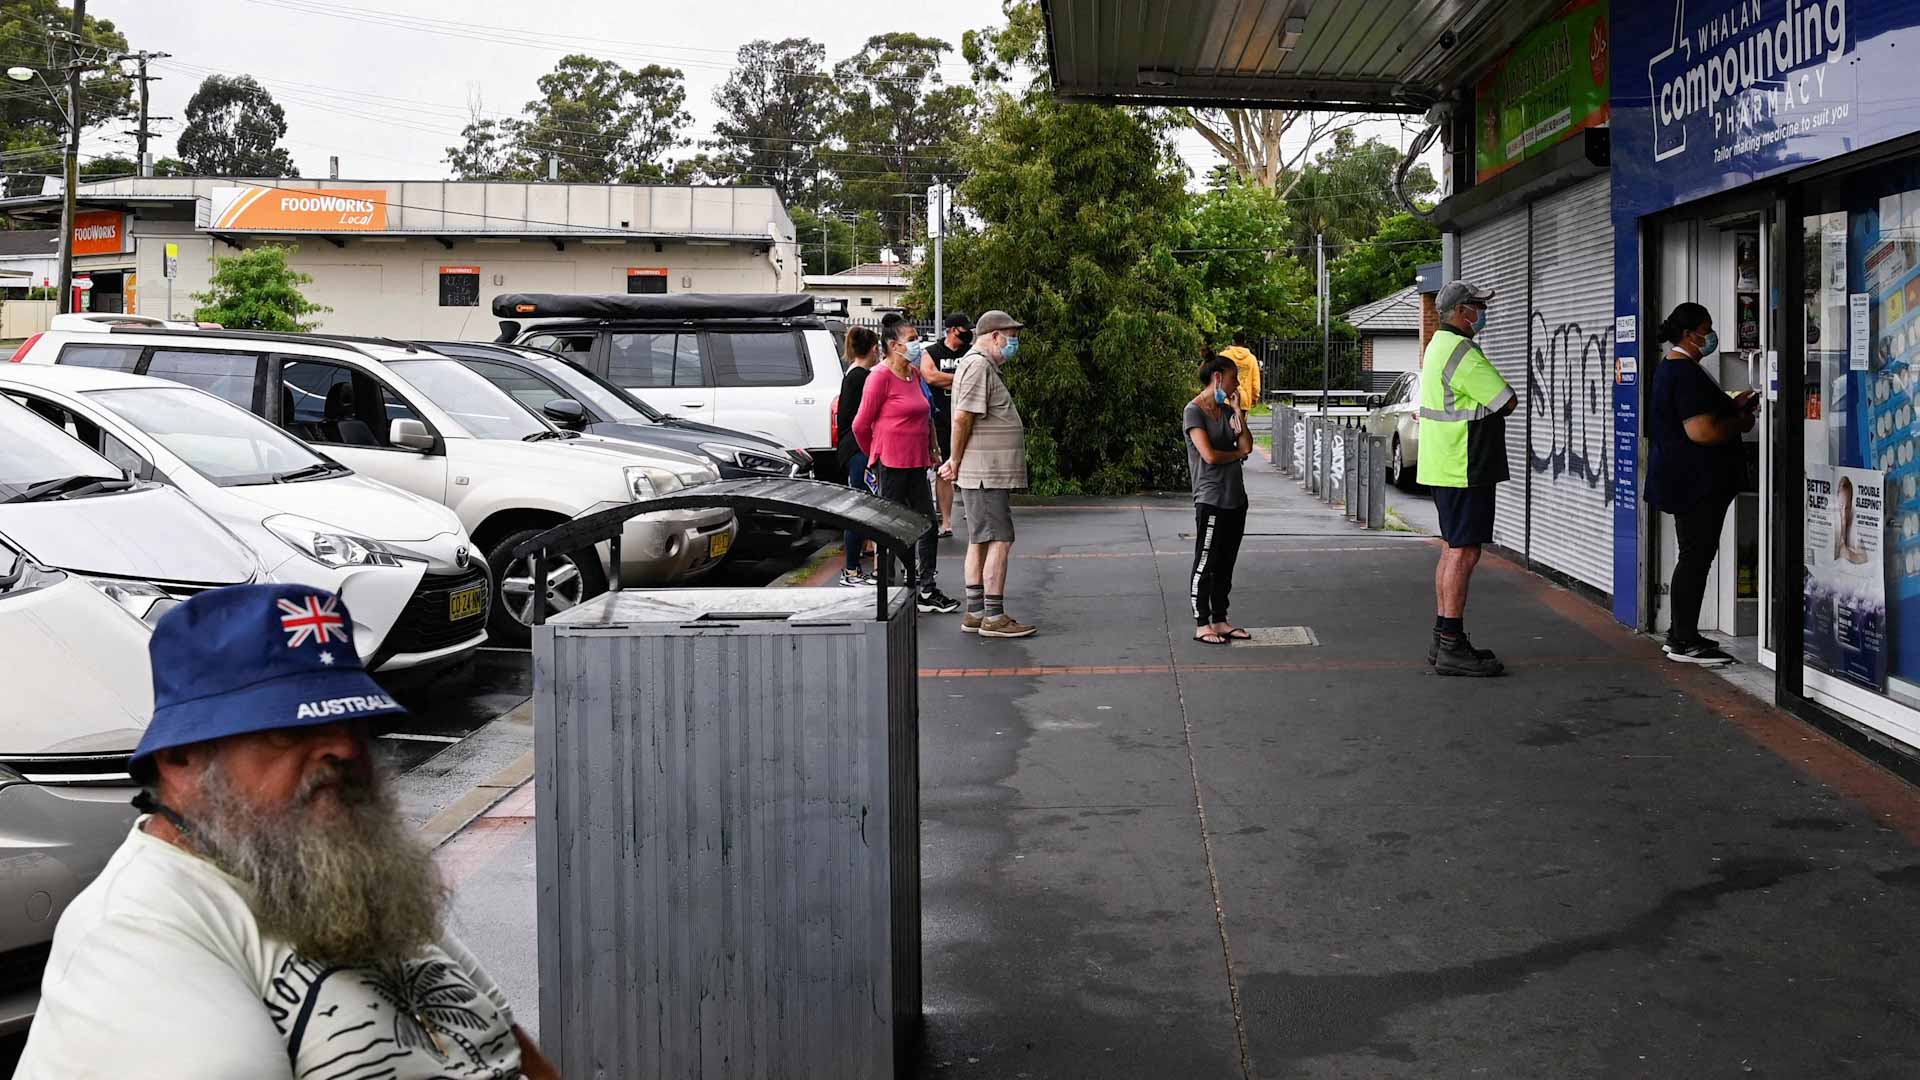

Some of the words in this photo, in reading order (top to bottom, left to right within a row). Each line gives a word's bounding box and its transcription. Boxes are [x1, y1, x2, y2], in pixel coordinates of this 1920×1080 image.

[1698, 0, 1761, 53] WHALAN
[1660, 0, 1846, 127] compounding
[1715, 66, 1826, 139] PHARMACY
[1714, 145, 1733, 163] Tailor
[1734, 137, 1761, 155] making
[1762, 123, 1799, 145] medicine
[1800, 114, 1810, 132] to
[1812, 108, 1830, 128] suit
[1831, 103, 1849, 124] you
[281, 197, 374, 213] FOODWORKS
[338, 213, 373, 225] Local
[74, 225, 116, 241] FOODWORKS
[1858, 485, 1880, 498] TROUBLE
